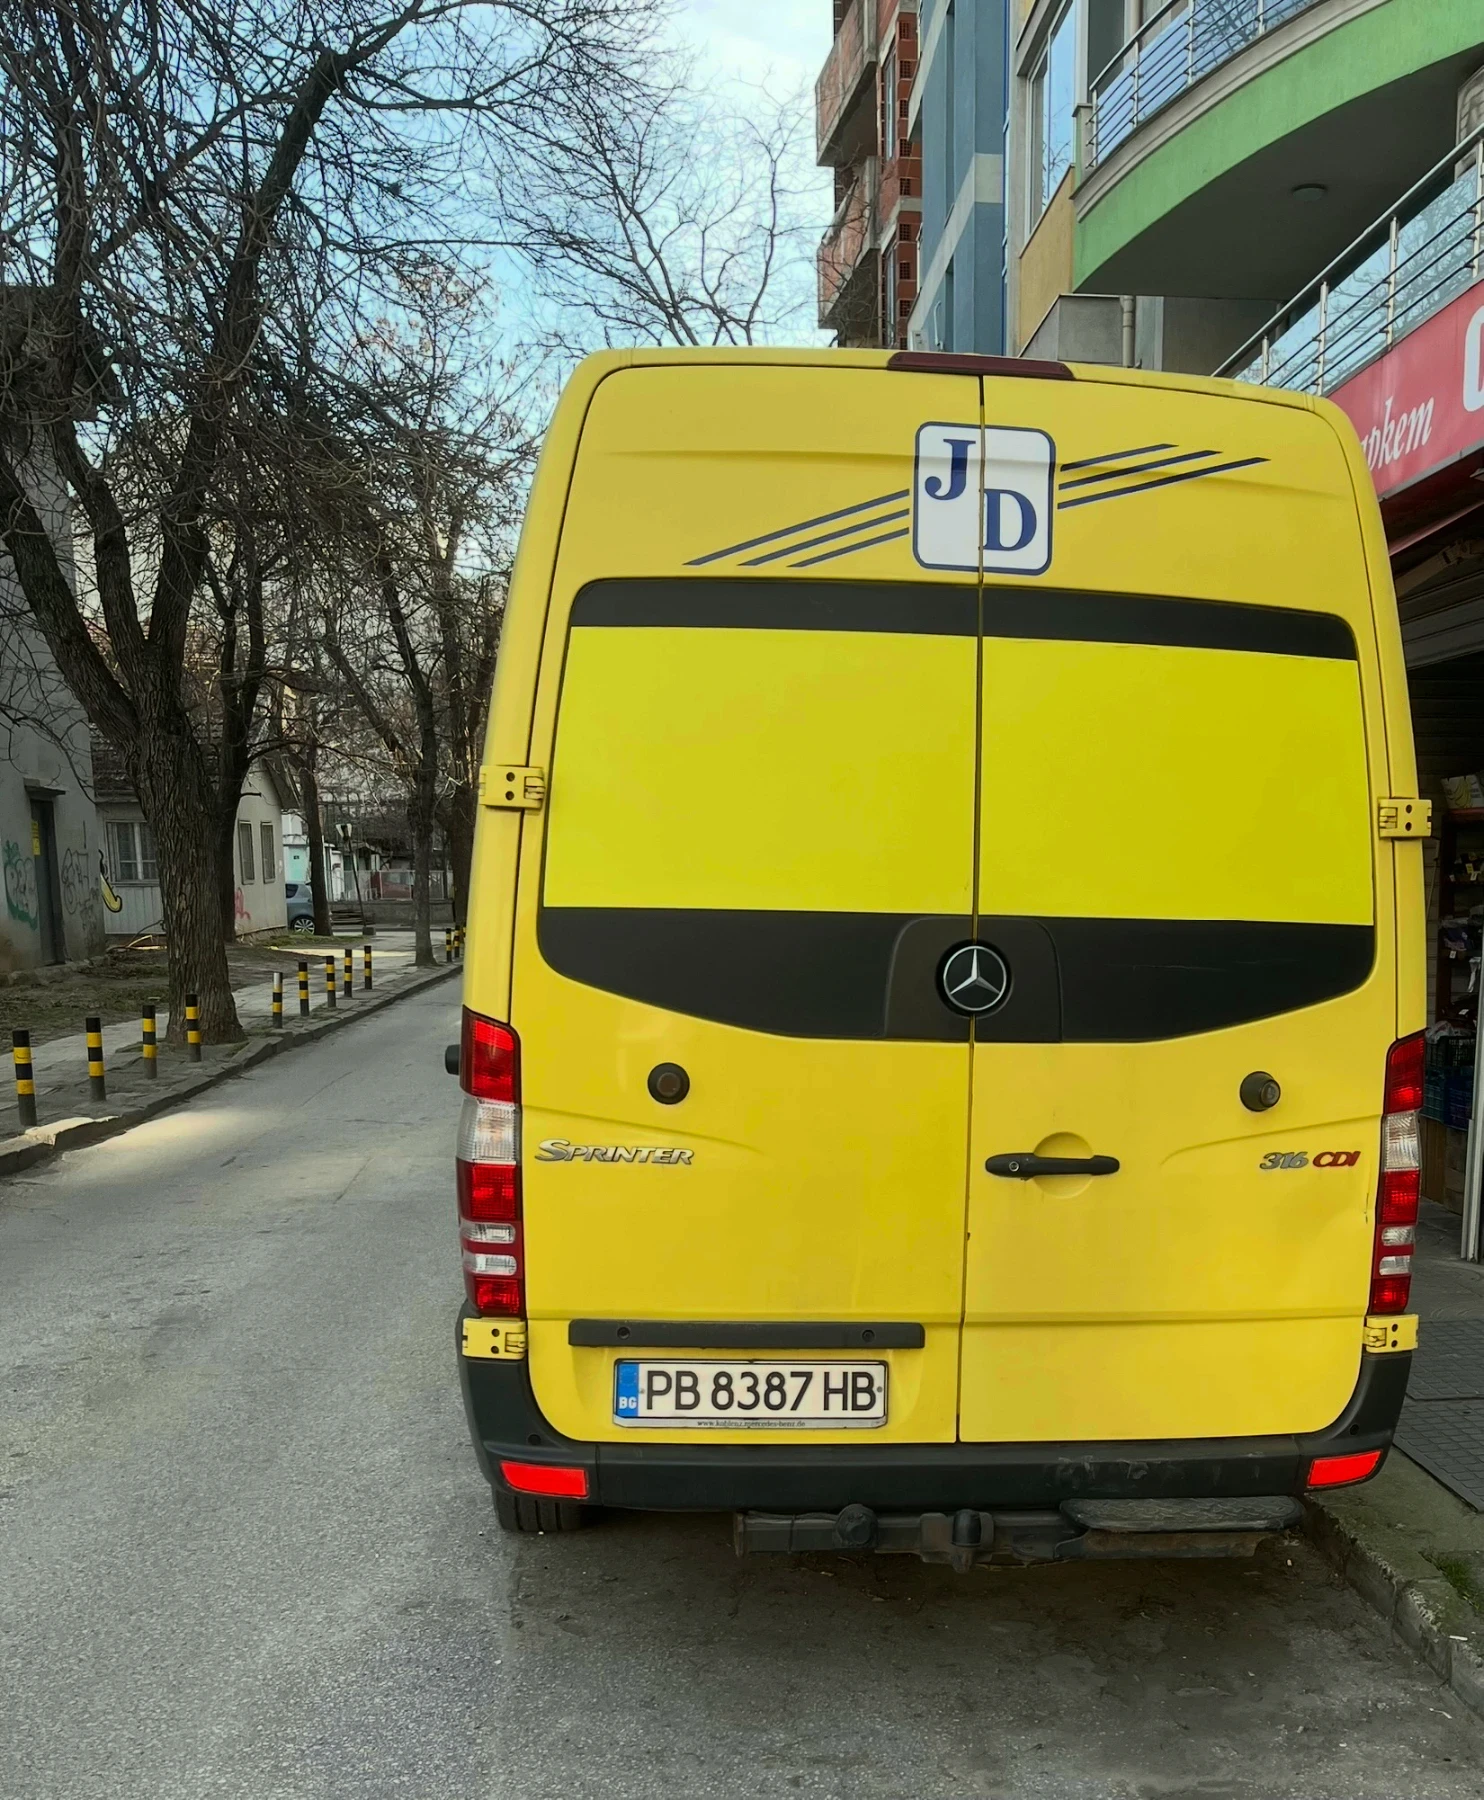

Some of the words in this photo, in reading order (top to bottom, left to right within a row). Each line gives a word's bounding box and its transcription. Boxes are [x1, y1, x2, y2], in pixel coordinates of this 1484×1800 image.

[1259, 1151, 1309, 1170] 316
[1312, 1150, 1362, 1168] CDI
[646, 1370, 701, 1411] PB
[710, 1371, 814, 1411] 8387
[823, 1371, 877, 1412] HB
[619, 1396, 637, 1410] BG
